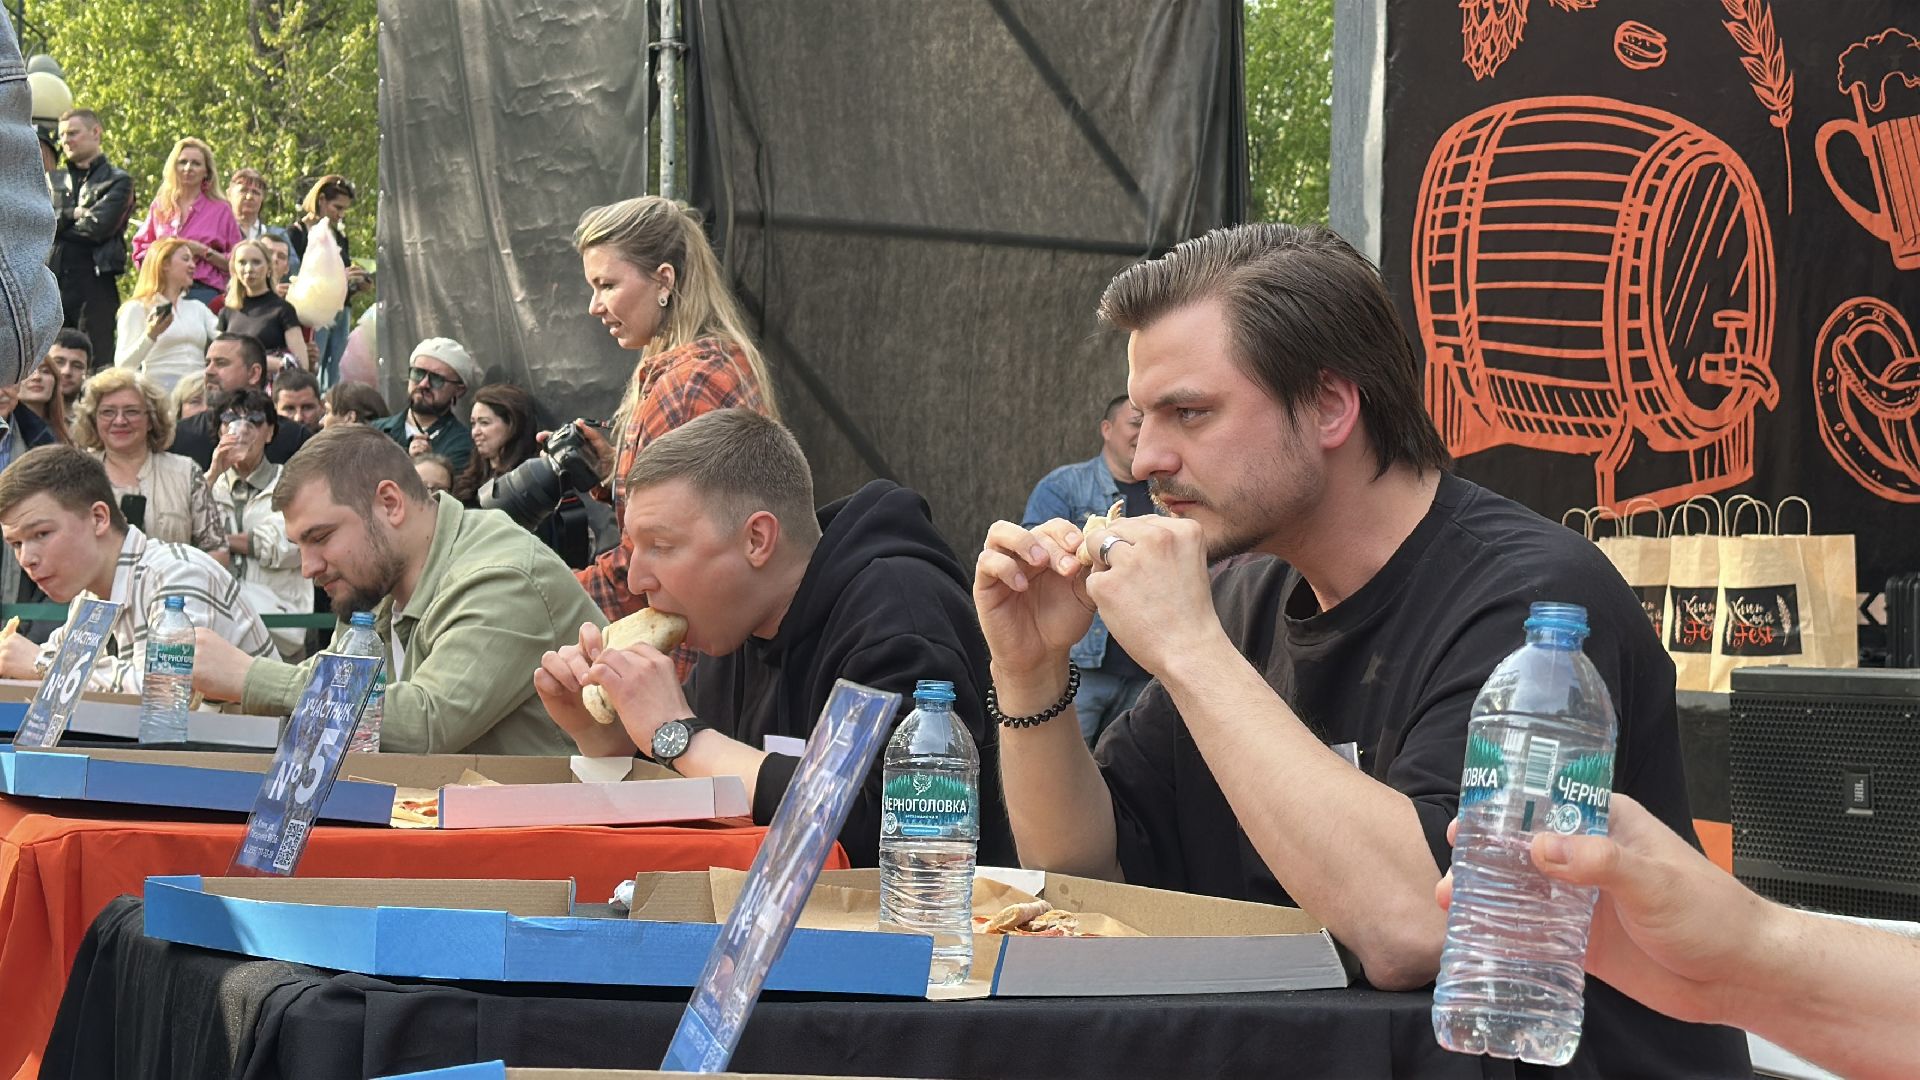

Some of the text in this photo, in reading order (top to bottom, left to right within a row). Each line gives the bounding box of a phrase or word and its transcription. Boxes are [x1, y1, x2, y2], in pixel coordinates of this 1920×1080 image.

[1684, 620, 1713, 645] Fe
[1733, 621, 1774, 647] Fest
[301, 697, 355, 721] УЧАСТНИК
[267, 727, 341, 804] №5
[885, 795, 967, 813] ЧЕРНОГОЛОВКА
[1558, 775, 1611, 808] ЧЕРНОГ
